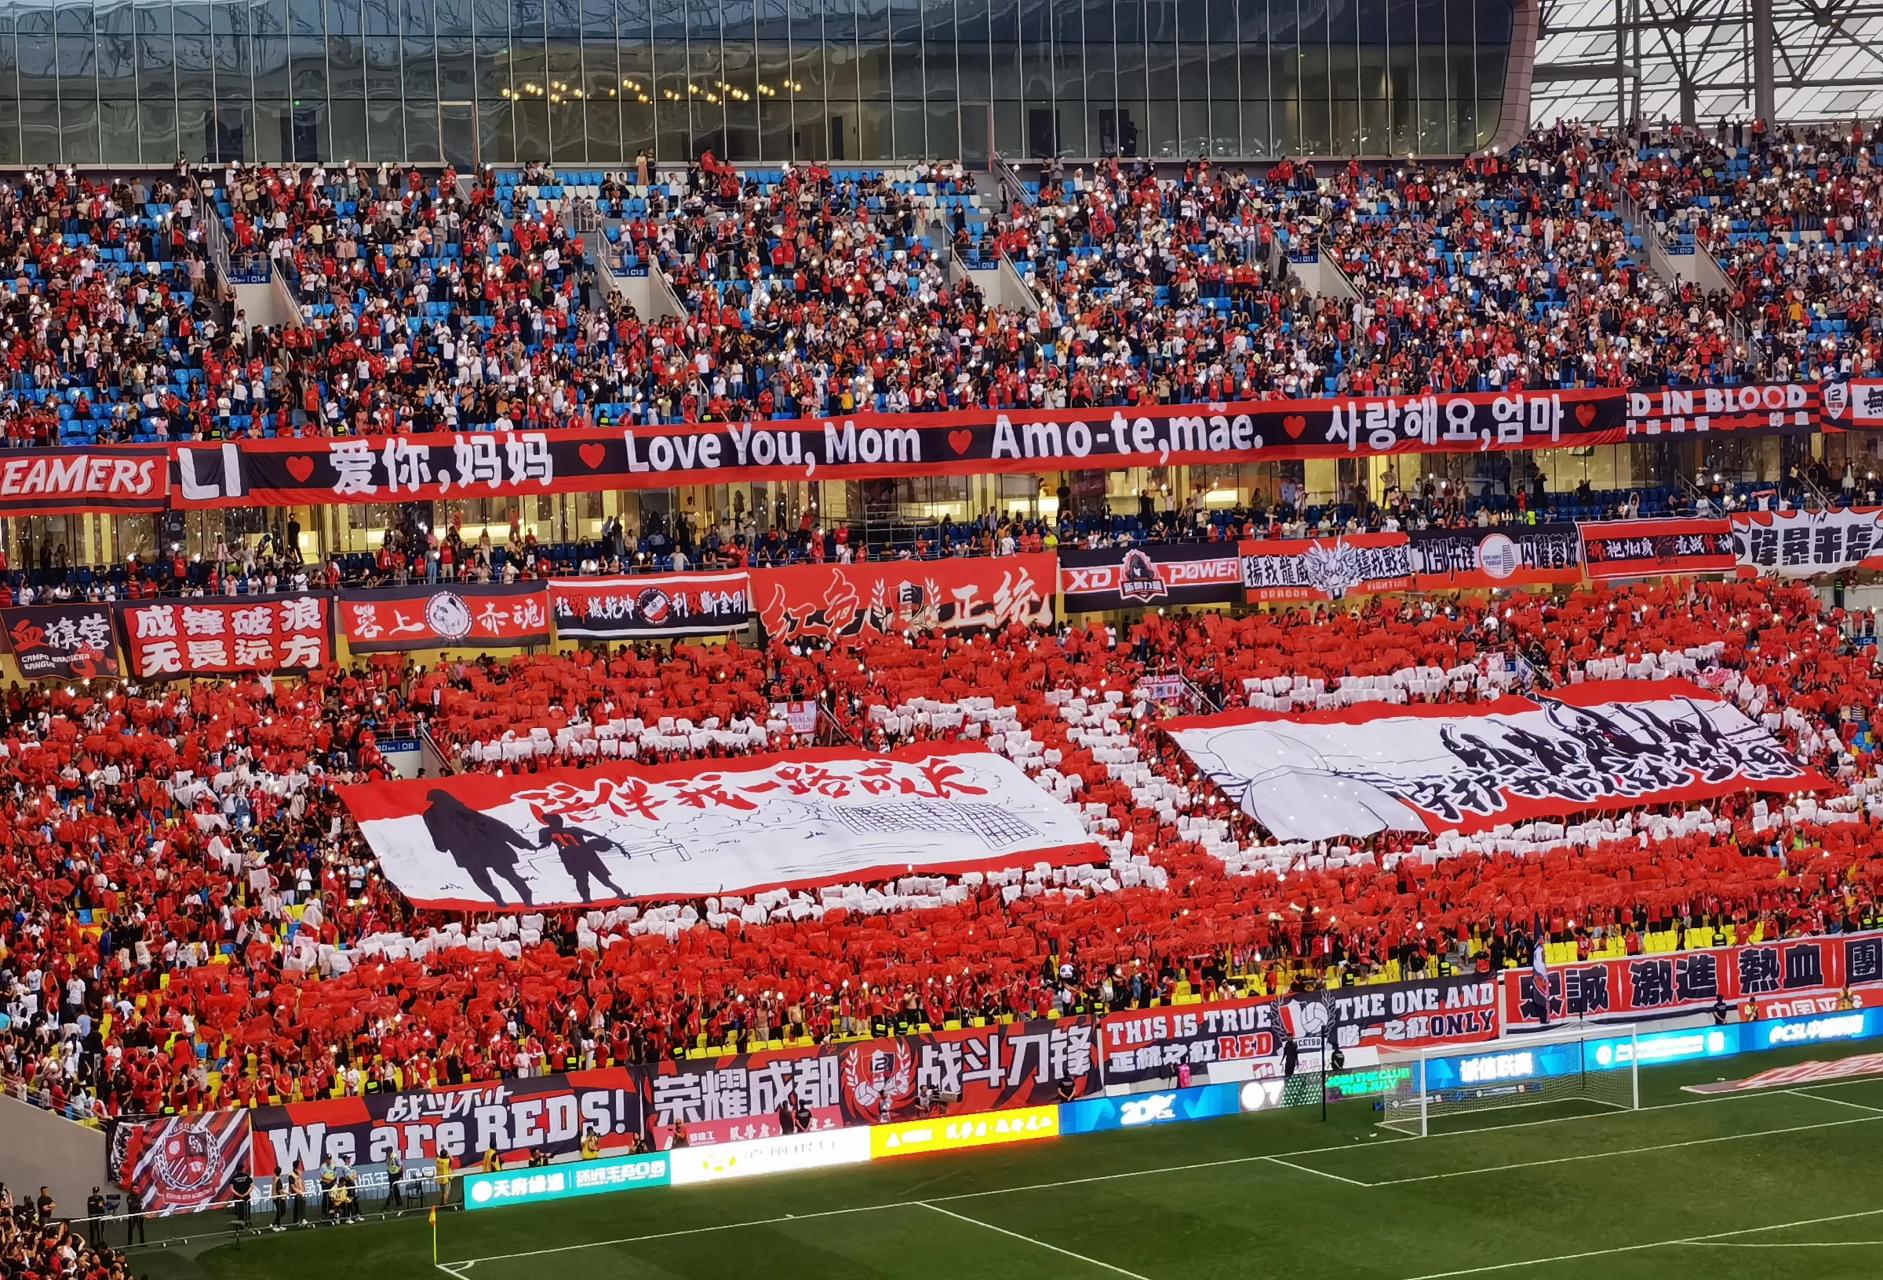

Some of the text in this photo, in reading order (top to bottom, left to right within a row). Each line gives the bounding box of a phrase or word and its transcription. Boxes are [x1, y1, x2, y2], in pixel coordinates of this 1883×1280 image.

[1662, 390, 1693, 416] IN
[1705, 384, 1808, 413] BLOOD
[624, 420, 921, 477] Love You, Mom
[1, 455, 156, 495] EAMERS
[1066, 568, 1112, 592] XD
[1336, 982, 1495, 1023] THE ONE AND
[1430, 1008, 1496, 1037] ONLY
[1107, 1005, 1273, 1047] THIS IS TRUE
[1218, 1031, 1273, 1060] RED
[653, 1055, 840, 1128] 荣耀成都
[269, 1089, 626, 1178] We are REDS!
